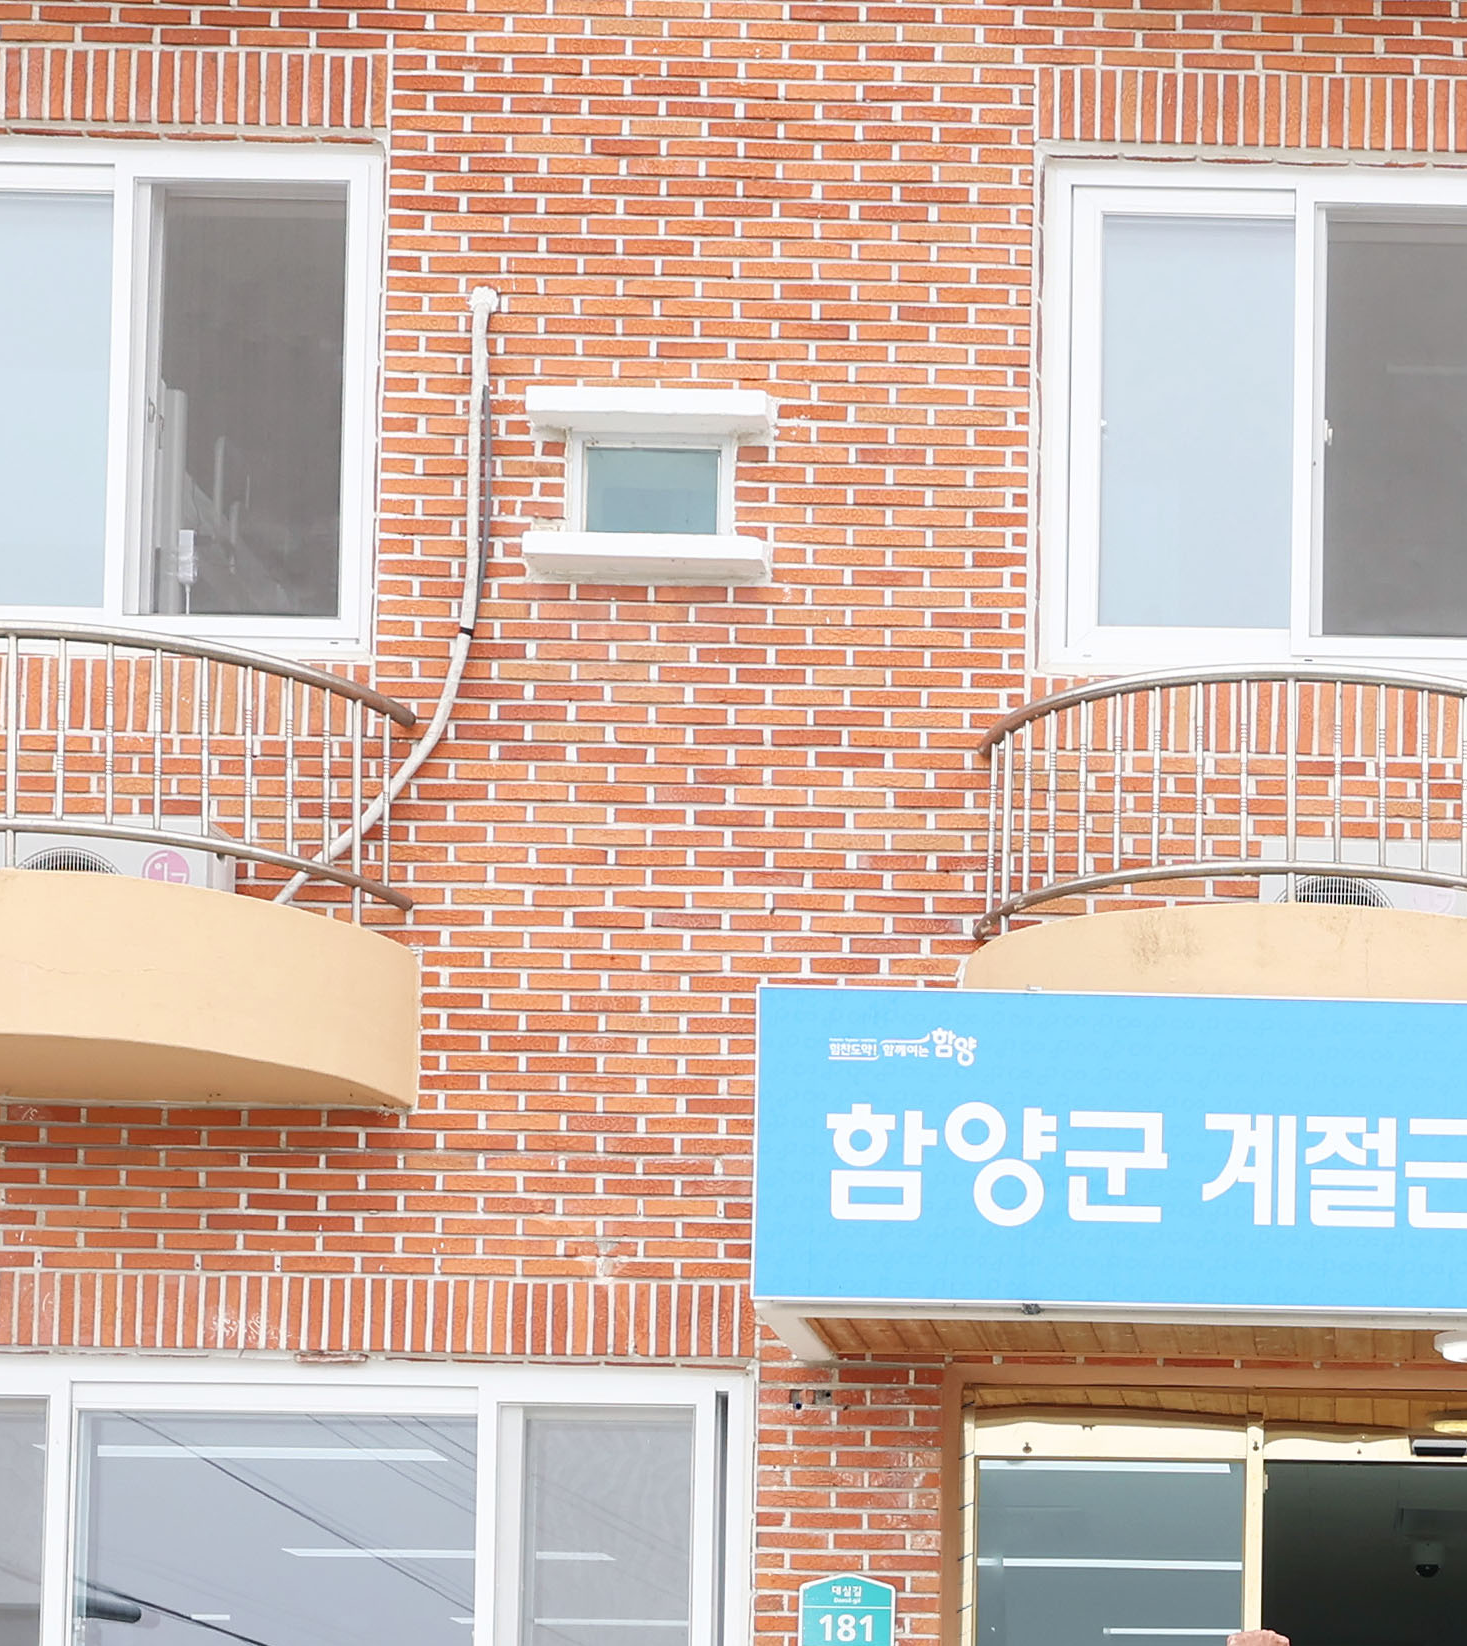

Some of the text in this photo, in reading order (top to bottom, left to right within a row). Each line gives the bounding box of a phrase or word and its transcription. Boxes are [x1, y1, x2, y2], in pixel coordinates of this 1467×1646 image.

[882, 1043, 931, 1058] 함께여는
[931, 1027, 978, 1067] 함양
[826, 1102, 1168, 1226] 함양군
[818, 1613, 874, 1643] 181
